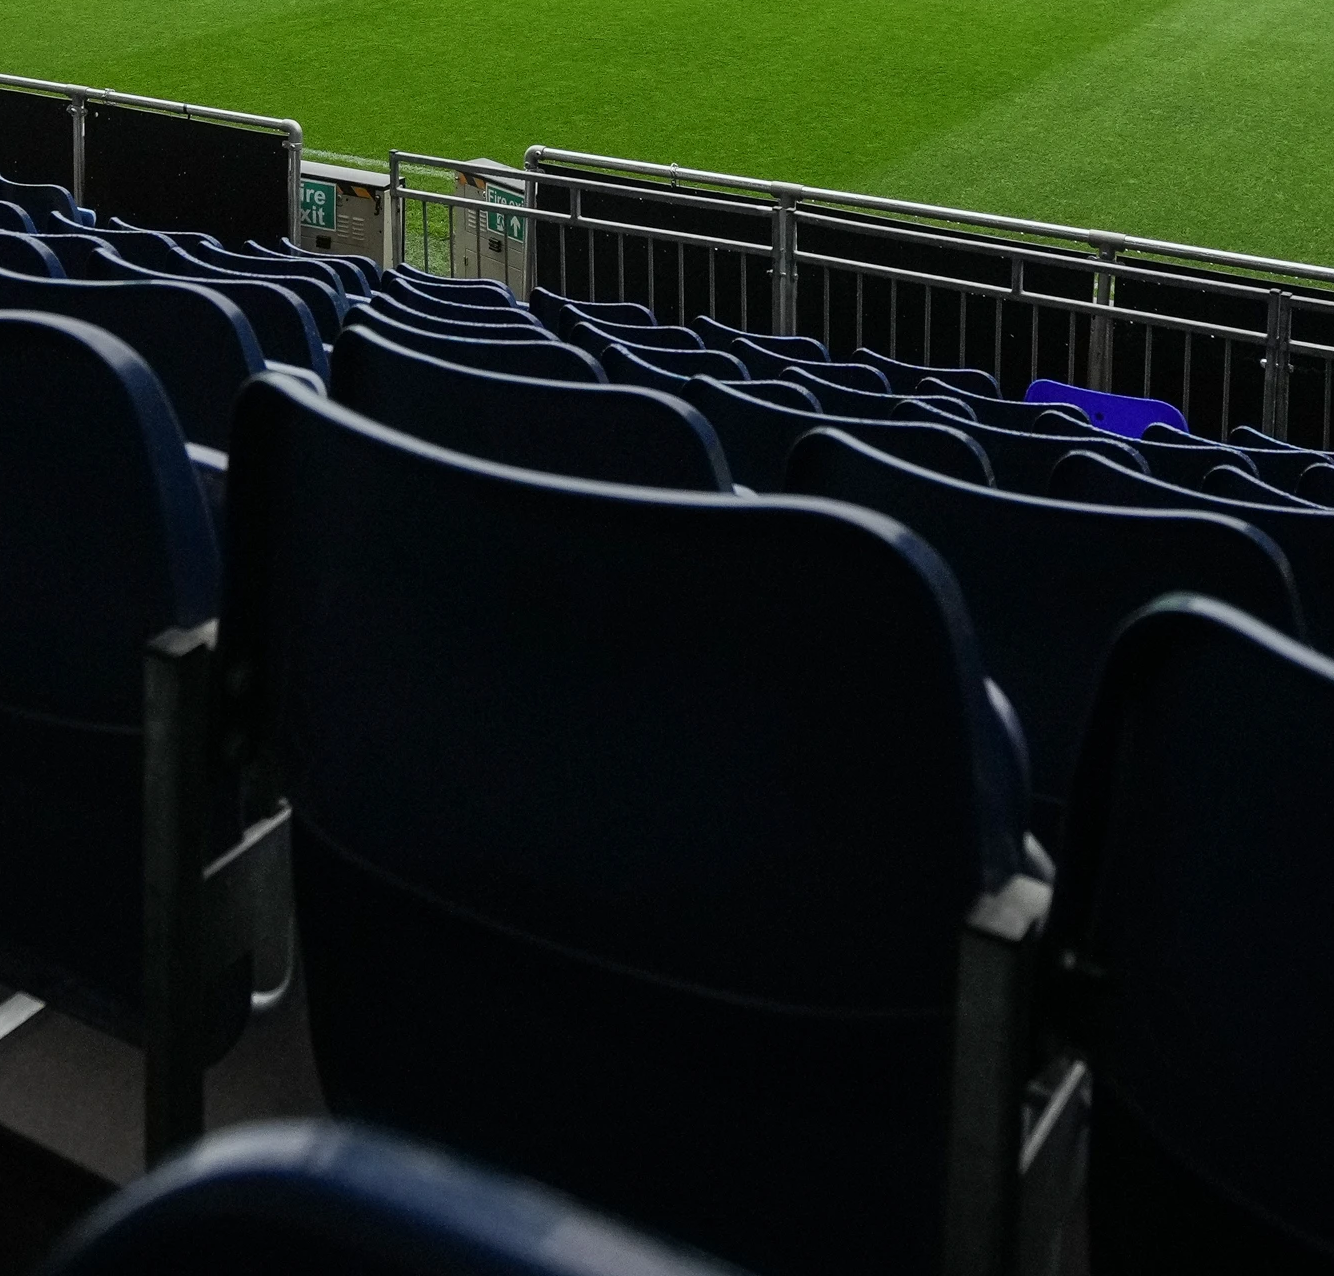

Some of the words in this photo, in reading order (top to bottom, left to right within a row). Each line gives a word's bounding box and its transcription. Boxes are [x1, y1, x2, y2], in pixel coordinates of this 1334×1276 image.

[300, 183, 326, 205] ire
[488, 187, 508, 205] Fire
[300, 205, 326, 225] xit
